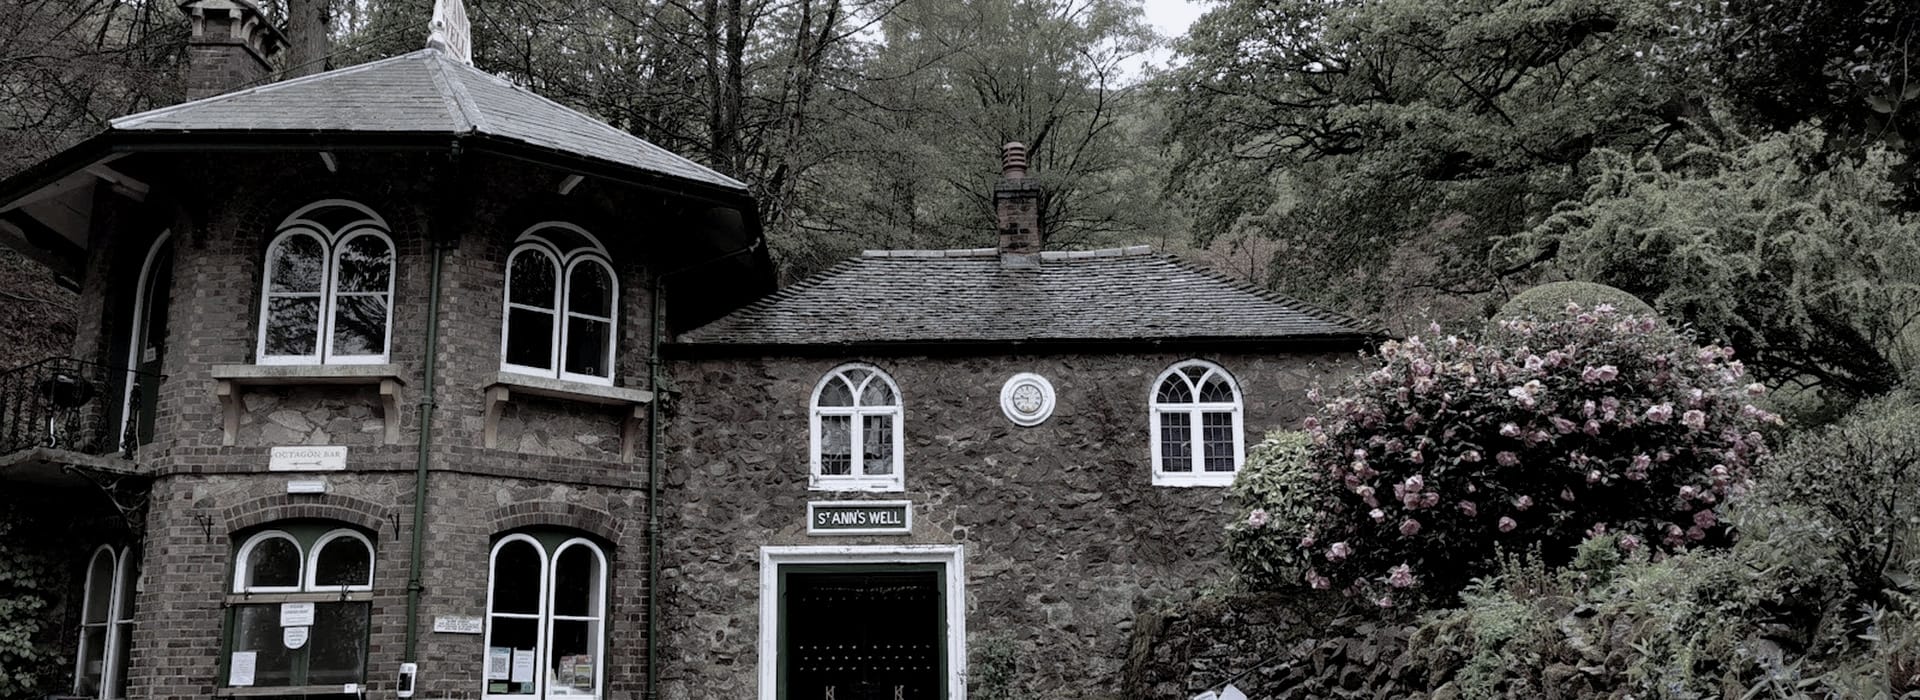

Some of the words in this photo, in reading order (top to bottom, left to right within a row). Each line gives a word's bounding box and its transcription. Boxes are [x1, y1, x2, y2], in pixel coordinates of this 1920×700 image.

[274, 451, 320, 459] OCTAGON
[831, 509, 866, 525] ANN'S
[868, 511, 901, 524] WELL
